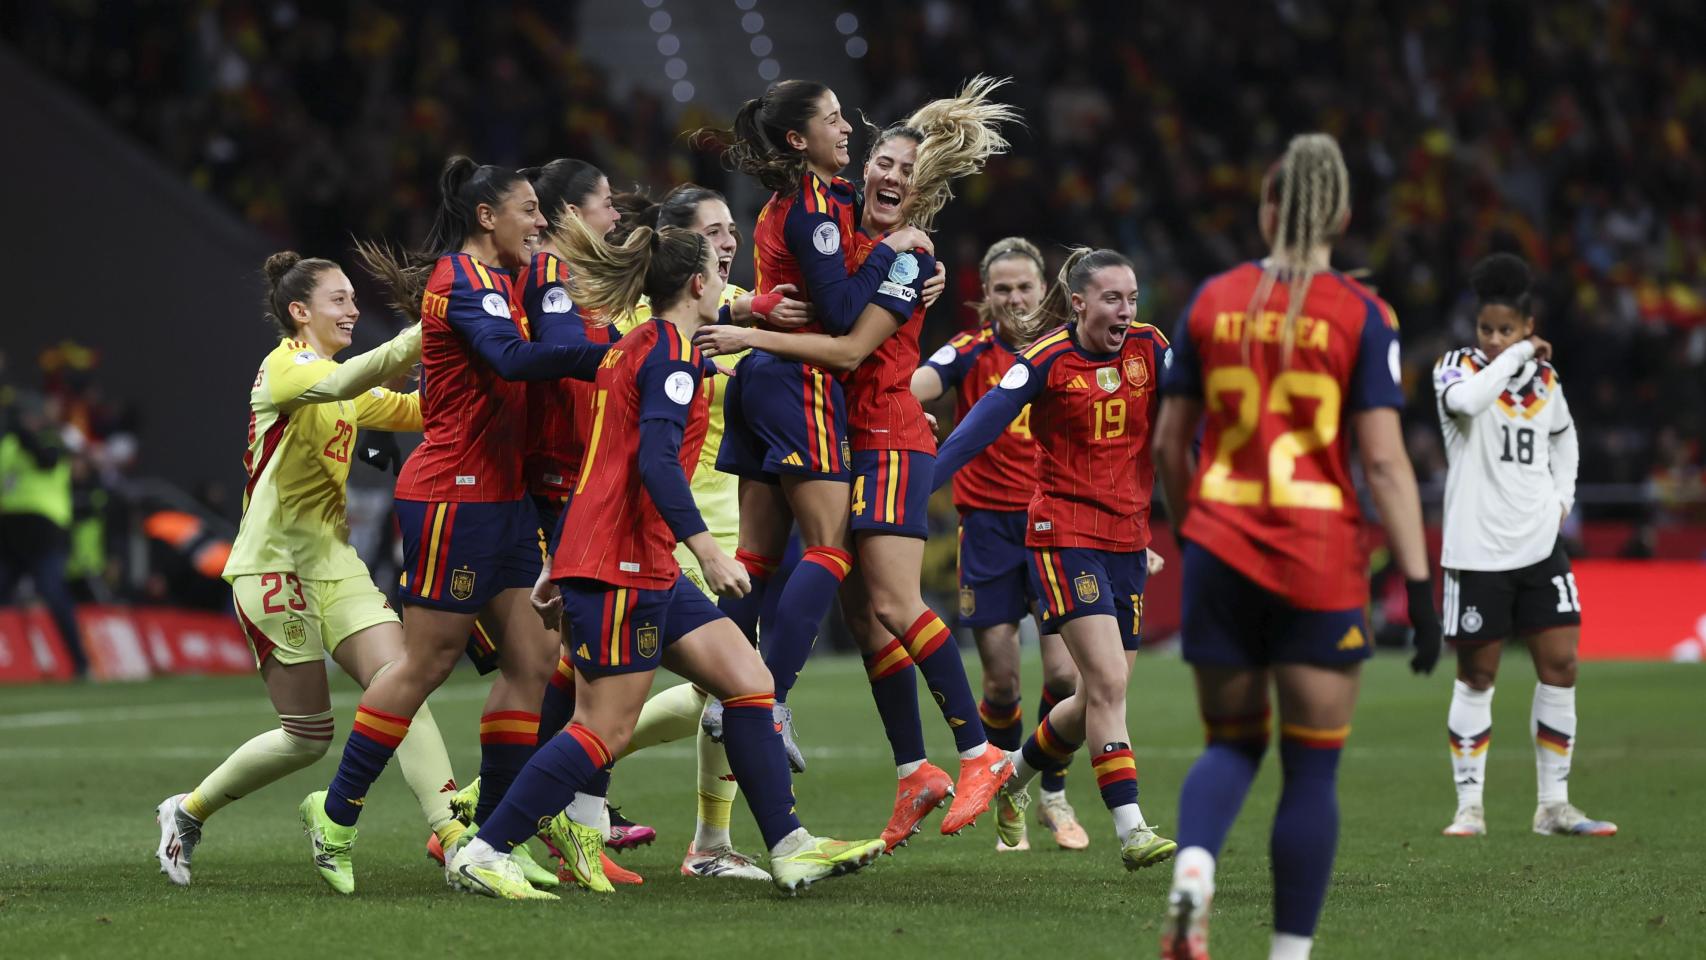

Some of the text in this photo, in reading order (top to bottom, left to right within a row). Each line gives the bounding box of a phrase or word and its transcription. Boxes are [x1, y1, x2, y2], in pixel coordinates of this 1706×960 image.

[1094, 399, 1127, 440] 19
[1200, 366, 1343, 511] 22
[324, 419, 354, 463] 23
[1500, 425, 1534, 463] 18
[261, 572, 307, 614] 23
[1130, 593, 1144, 635] 1
